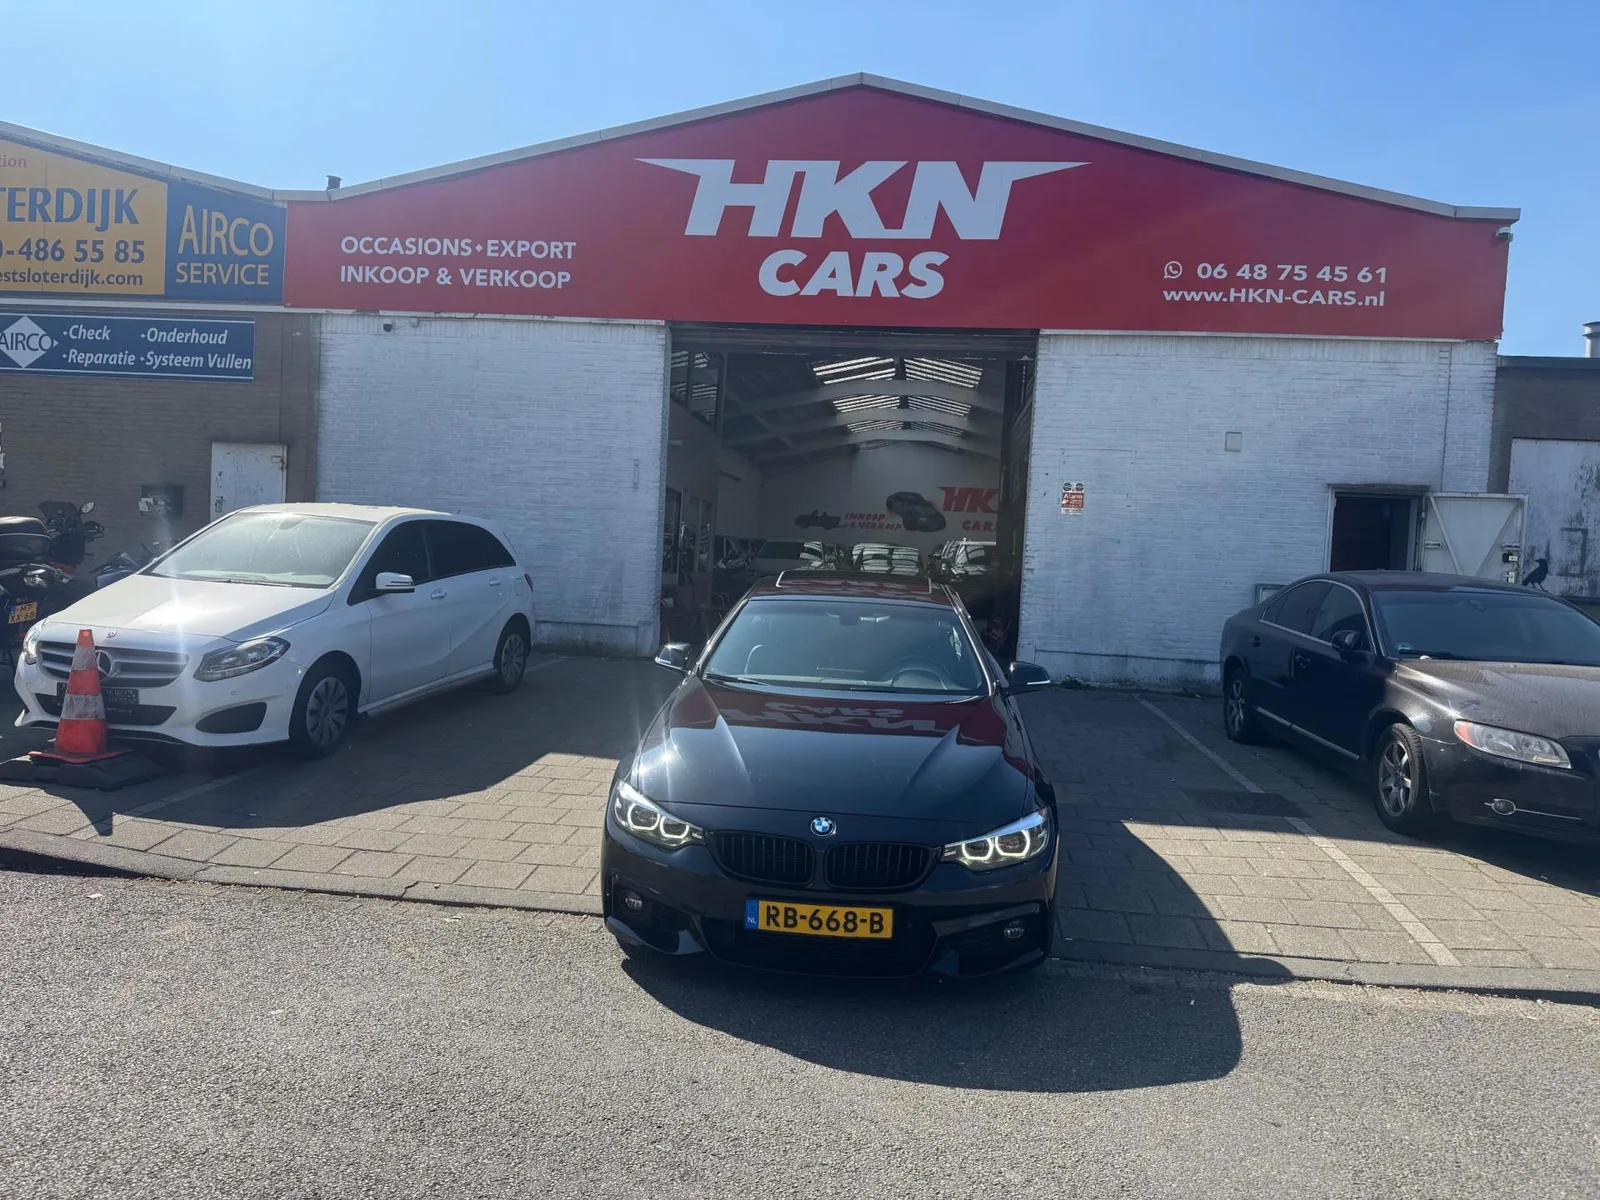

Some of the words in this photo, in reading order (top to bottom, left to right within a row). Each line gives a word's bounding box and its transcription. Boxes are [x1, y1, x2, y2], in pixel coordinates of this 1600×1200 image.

[633, 157, 1092, 240] HKN
[178, 204, 274, 257] AIRCO
[0, 237, 65, 263] -486
[74, 239, 104, 263] 55
[114, 239, 145, 263] 85
[340, 236, 472, 256] OCCASIONS
[486, 239, 577, 259] EXPORT
[176, 262, 269, 286] SERVICE
[340, 265, 430, 285] INKOOP
[436, 267, 453, 285] &
[459, 268, 571, 289] VERKOOP
[758, 249, 950, 299] CARS
[1196, 262, 1228, 280] 06
[1236, 263, 1268, 281] 48
[1277, 264, 1308, 281] 75
[1316, 265, 1348, 282] 45
[1356, 266, 1387, 284] 61
[1162, 288, 1385, 307] www.HKN-CARS.nl
[0, 332, 53, 352] AIRCO
[68, 324, 112, 341] Check
[146, 327, 228, 345] Onderhoud
[67, 349, 136, 367] Reparatie
[145, 351, 204, 369] Systeem
[207, 353, 251, 370] Vullen
[938, 486, 999, 513] HK
[962, 520, 998, 532] CAR
[747, 916, 757, 924] NL
[765, 904, 884, 934] RB-668-B
